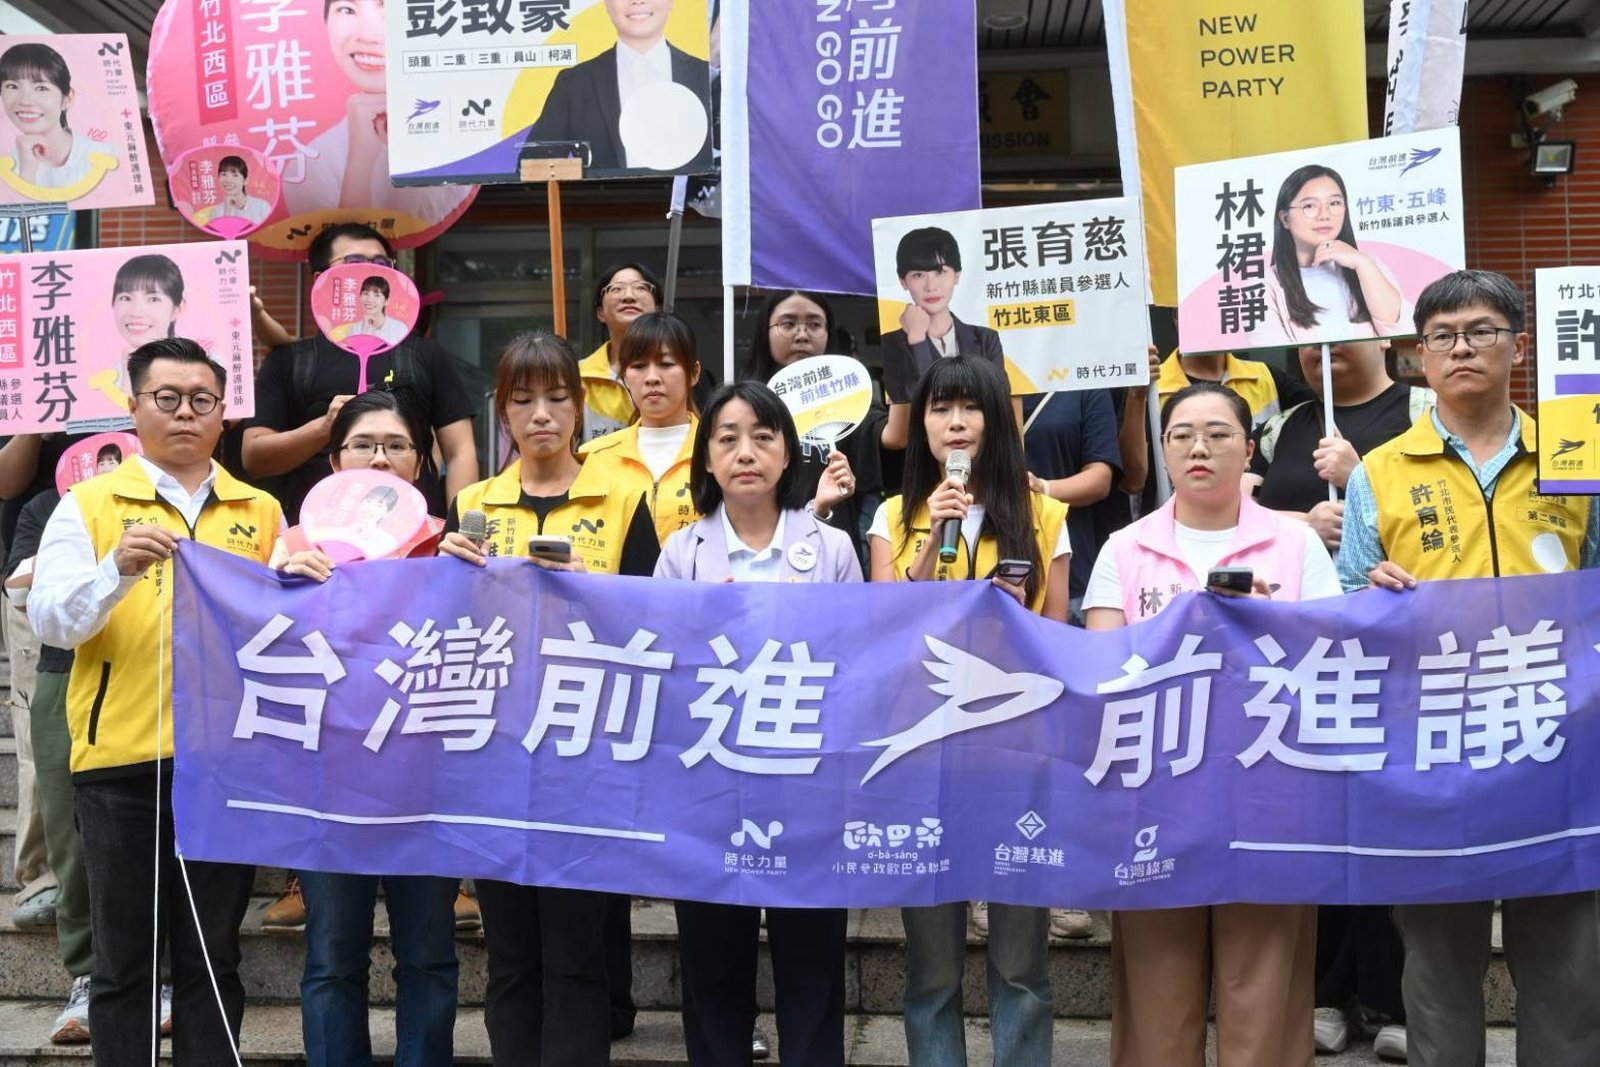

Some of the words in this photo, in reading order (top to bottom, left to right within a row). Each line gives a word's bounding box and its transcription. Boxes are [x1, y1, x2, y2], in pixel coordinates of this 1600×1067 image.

[1199, 14, 1257, 36] NEW
[408, 55, 432, 68] 頭重
[443, 53, 467, 66] 二重
[478, 52, 502, 65] 三重
[513, 50, 537, 63] 員山
[816, 31, 842, 86] GO
[1201, 44, 1295, 68] POWER
[847, 0, 905, 149] 前進
[1202, 77, 1284, 99] PARTY
[817, 94, 843, 148] GO
[1358, 211, 1449, 231] 新竹縣議員參選人
[982, 216, 1128, 271] 張育慈
[1215, 178, 1268, 334] 林裙靜
[342, 277, 358, 320] 李雅芬
[986, 271, 1130, 299] 新竹縣議員參選人
[1557, 283, 1600, 300] 竹北
[993, 303, 1071, 327] 竹北東區
[31, 260, 78, 424] 李雅芬
[774, 364, 833, 396] 台灣前進
[1076, 363, 1137, 379] 時代力量
[11, 378, 23, 420] 參選人
[800, 371, 860, 405] 前進竹縣
[1139, 587, 1163, 617] 林
[232, 613, 835, 775] 台灣前進
[1083, 619, 1600, 789] 前進議
[724, 851, 787, 869] 時代力量
[994, 843, 1066, 867] 台灣基進
